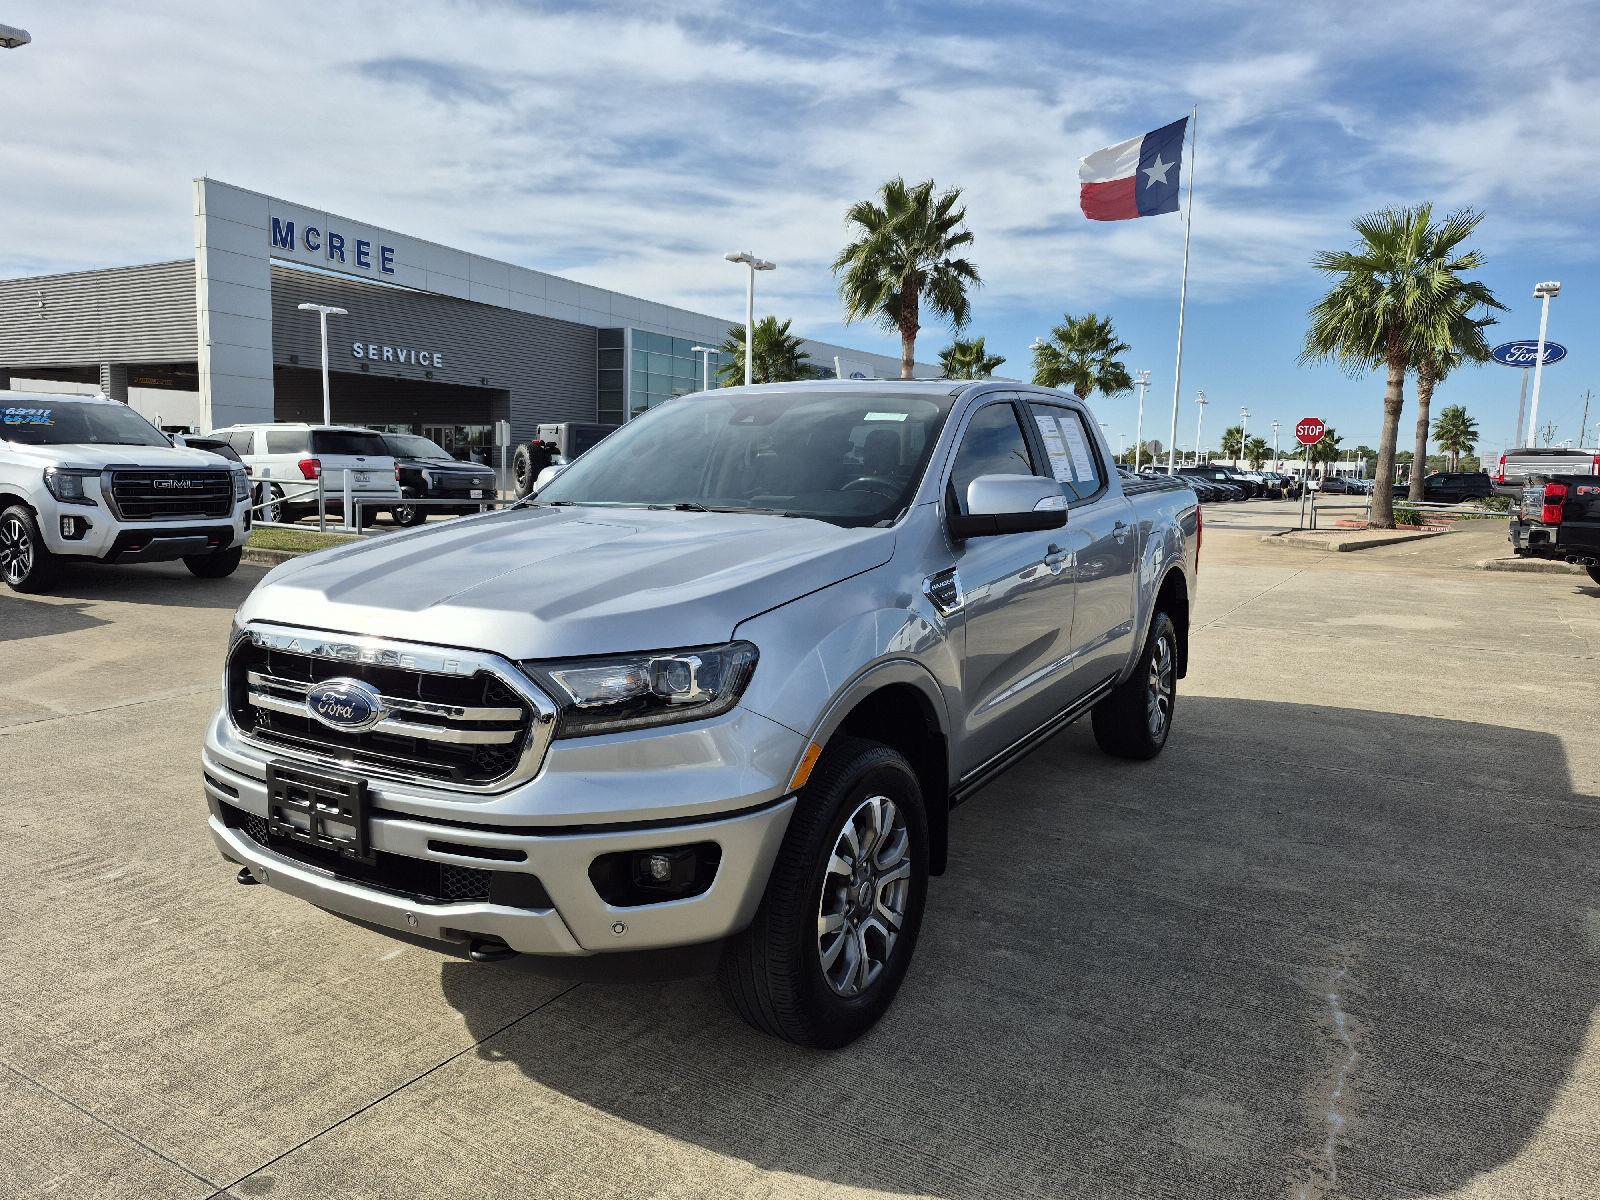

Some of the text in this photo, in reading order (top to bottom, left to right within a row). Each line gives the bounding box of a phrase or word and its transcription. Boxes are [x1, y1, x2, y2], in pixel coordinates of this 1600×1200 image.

[271, 216, 395, 275] MCREE
[353, 342, 442, 368] SERVICE
[1505, 345, 1553, 362] Ford
[1297, 425, 1323, 436] STOP
[153, 479, 204, 489] GMC
[258, 631, 460, 674] RANGER
[317, 691, 356, 719] Ford
